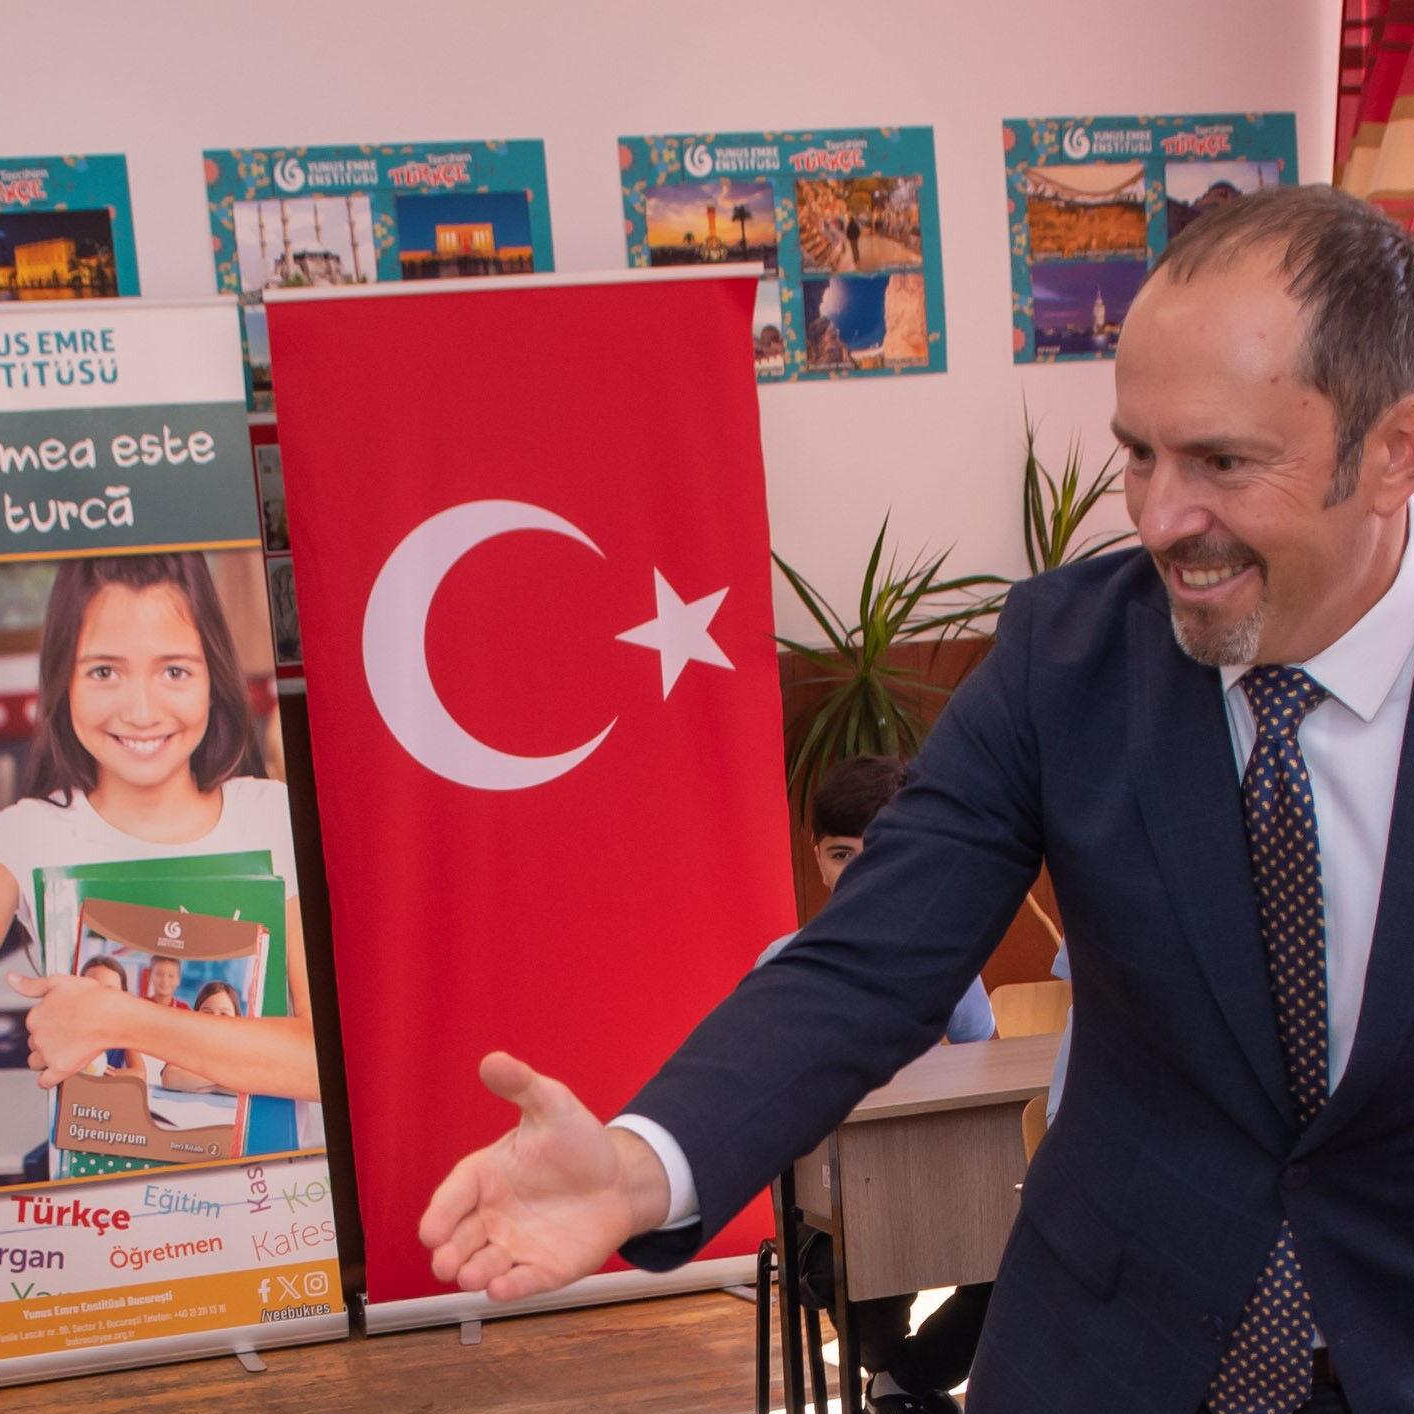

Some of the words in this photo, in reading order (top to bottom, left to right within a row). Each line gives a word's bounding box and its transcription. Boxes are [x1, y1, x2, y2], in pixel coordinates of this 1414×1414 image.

[38, 328, 115, 356] EMRE
[112, 424, 216, 469] este
[4, 485, 134, 534] turcă
[71, 1102, 111, 1122] Türkçe
[69, 1124, 147, 1145] Öğreniyorum
[210, 1145, 218, 1155] 2
[11, 1194, 132, 1236] Türkçe
[144, 1184, 222, 1219] Eğitim
[110, 1234, 224, 1271] Öğretmen
[252, 1219, 336, 1262] Kafes
